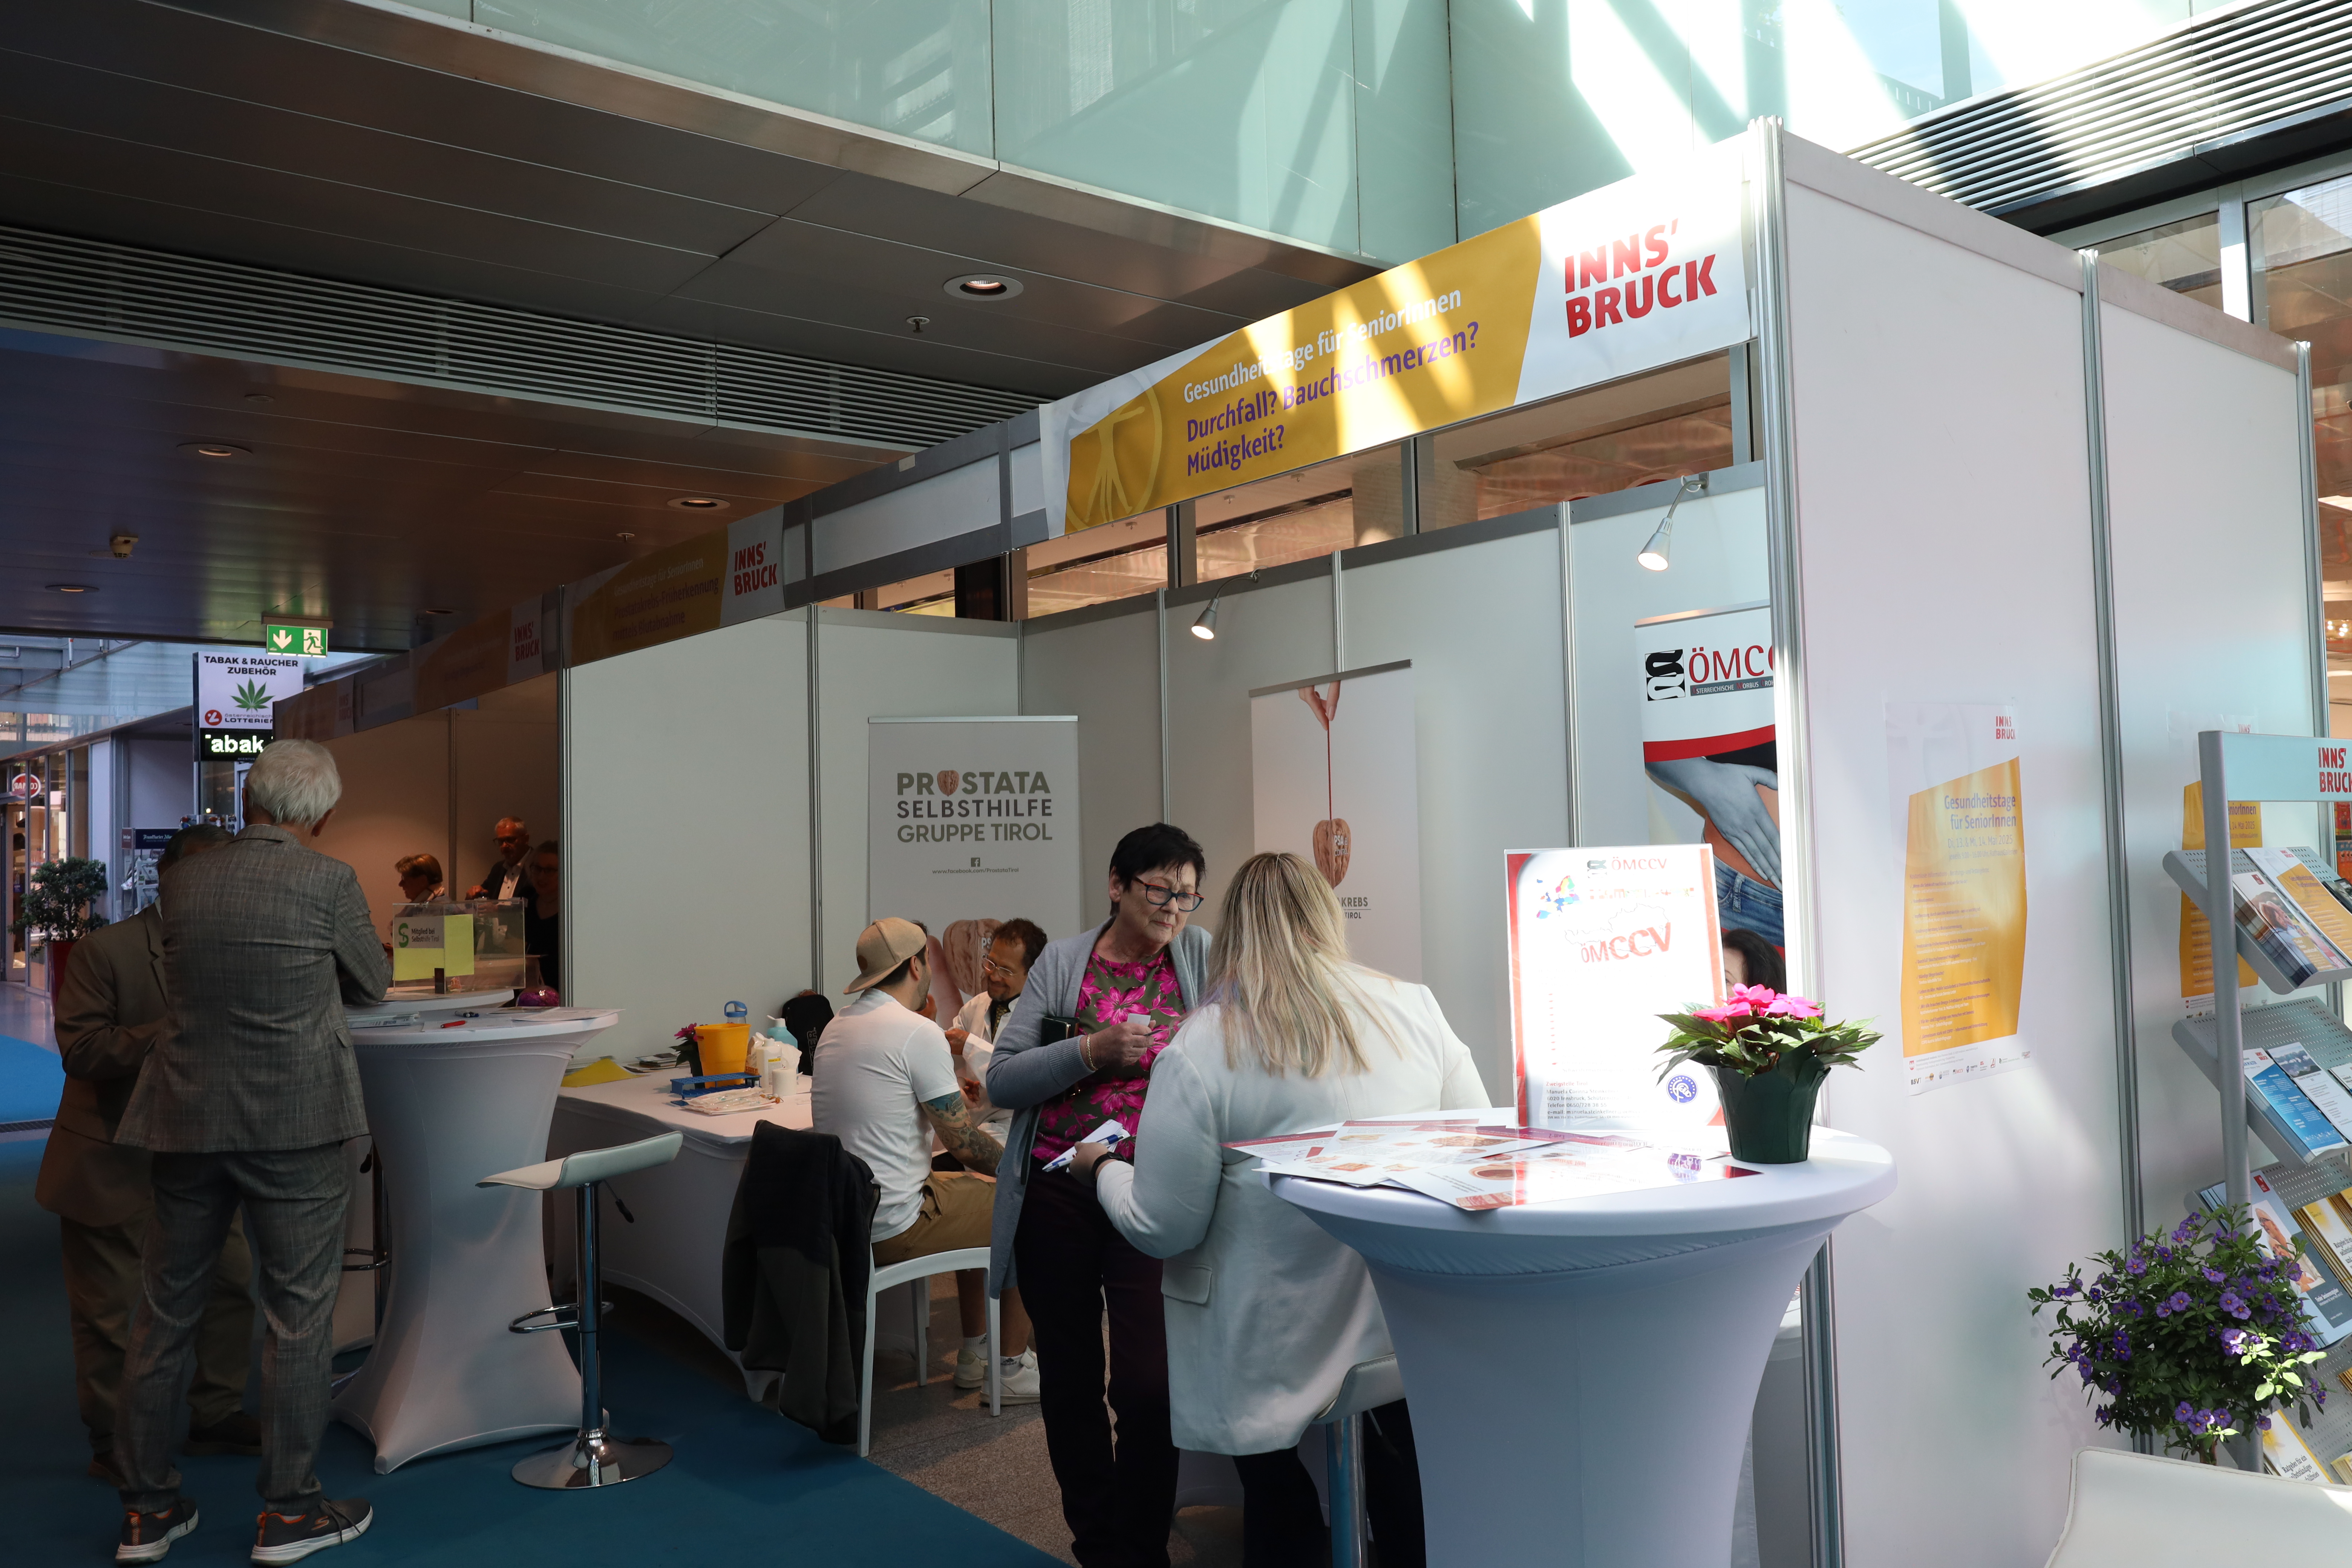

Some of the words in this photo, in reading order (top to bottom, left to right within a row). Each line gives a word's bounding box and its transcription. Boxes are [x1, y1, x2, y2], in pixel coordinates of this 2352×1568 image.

[1565, 217, 1678, 294] INNS'
[1566, 254, 1718, 338] BRUCK
[1184, 343, 1314, 403] Gesundheitstage
[1317, 329, 1343, 356] für
[1346, 289, 1461, 345] SeniorInnen
[1187, 391, 1278, 442] Durchfall?
[1283, 322, 1479, 410] Bauchschmerzen?
[1187, 424, 1285, 476] Müdigkeit?
[734, 541, 766, 572] INNS'
[614, 574, 657, 597] Gesundheitstage
[657, 569, 666, 582] für
[667, 557, 704, 579] SeniorInnen
[734, 563, 778, 596] BRUCK
[614, 577, 719, 620] Prostatakrebs-Früherkennung
[612, 624, 637, 642] mittels
[638, 611, 685, 635] Blutabnahme
[204, 656, 239, 664] TABAK
[250, 658, 299, 667] RAUCHER
[515, 638, 539, 662] BRUCK
[227, 666, 276, 675] ZUBEHÖR
[1689, 645, 1774, 683] ÖMC
[1692, 683, 1735, 695] ÖSTERREICHISCHE
[1736, 681, 1759, 690] MORBUS
[2318, 747, 2346, 769] INNS'
[897, 799, 1052, 818] SELBSTHILFE
[1944, 793, 2016, 811] Gesundheitstage
[897, 824, 985, 842] GRUPPE
[991, 823, 1052, 841] TIROL
[1950, 814, 1963, 830] für
[1965, 812, 2016, 829] SeniorInnen
[1334, 835, 1344, 845] PSA
[1999, 835, 2013, 845] 2025
[1611, 856, 1667, 870] ÖMCCV
[1580, 922, 1671, 963] ÖMCCV
[2282, 1459, 2298, 1473] Ratgeber
